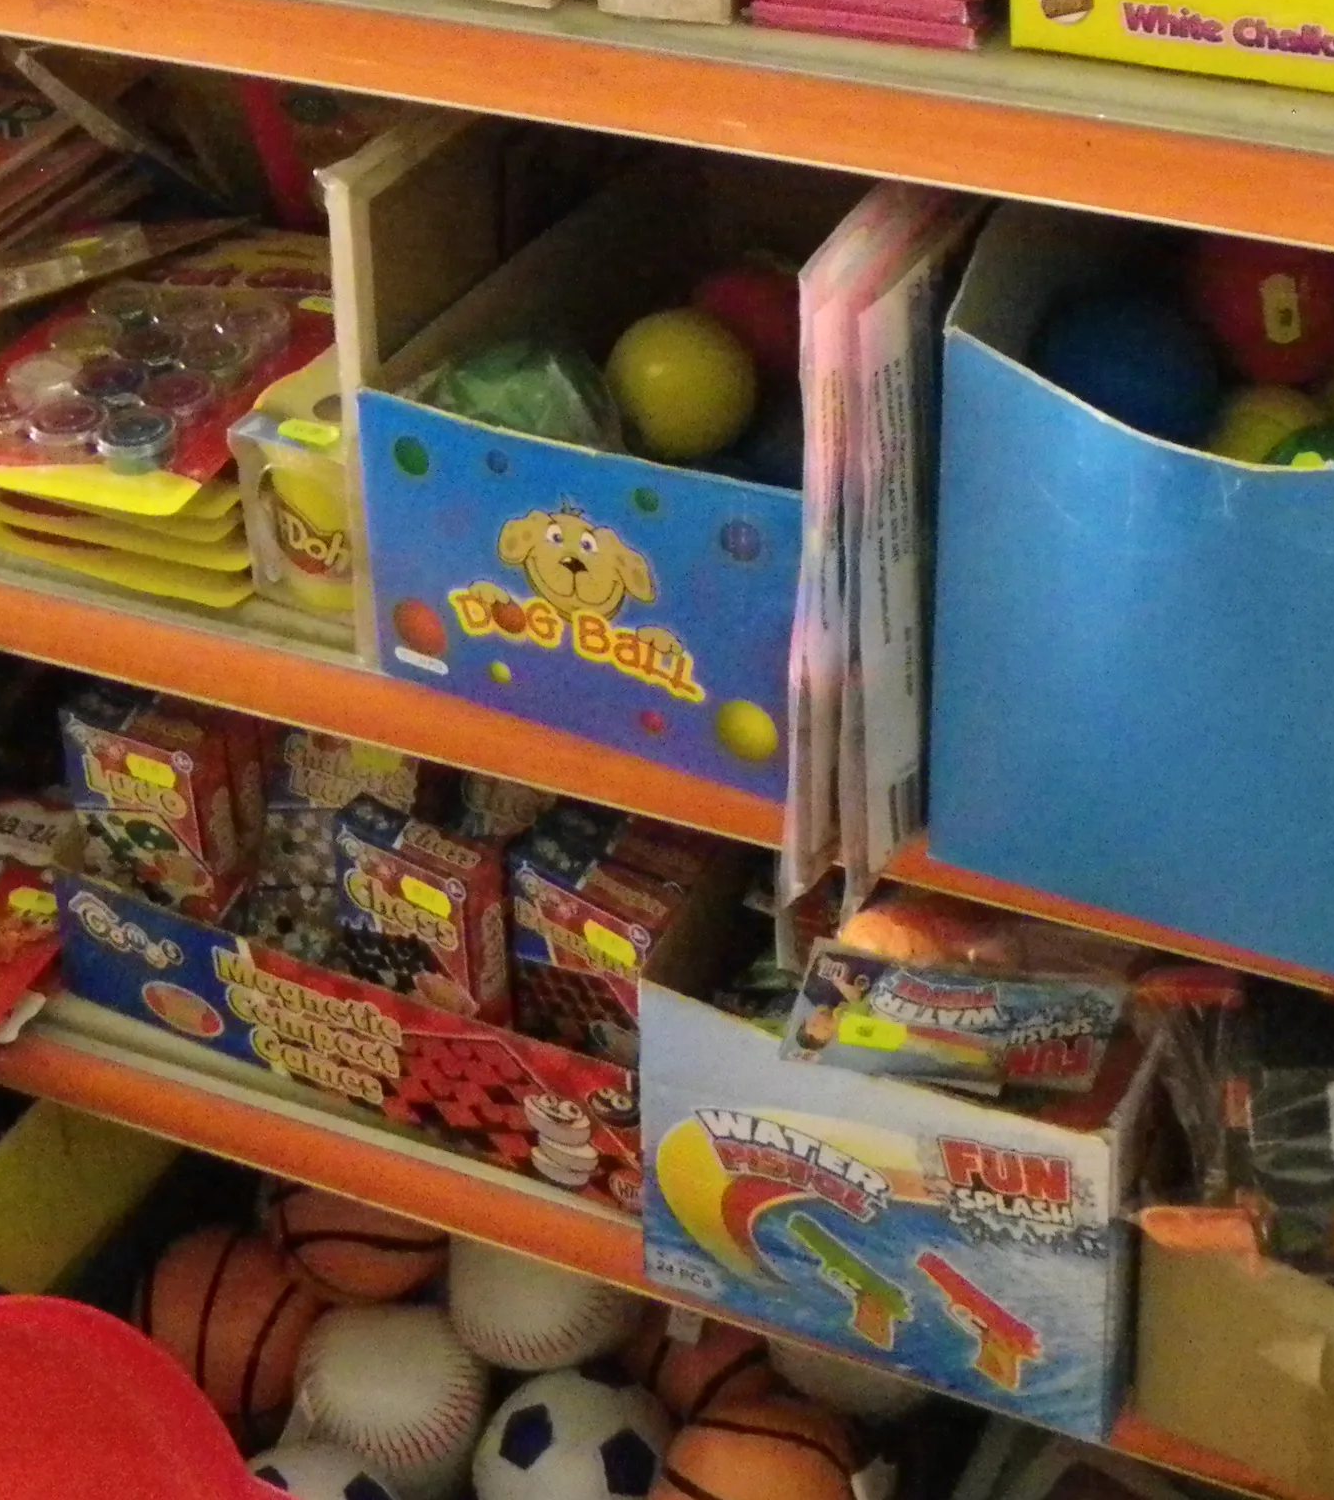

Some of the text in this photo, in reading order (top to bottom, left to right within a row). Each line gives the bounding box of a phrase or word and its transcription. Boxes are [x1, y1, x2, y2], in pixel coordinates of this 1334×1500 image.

[1122, 0, 1225, 45] White
[345, 870, 457, 950] Chess
[215, 949, 402, 1045] Magnetic
[230, 987, 400, 1077] Compact
[252, 1030, 383, 1103] Games
[697, 1108, 890, 1197] WATER
[941, 1136, 1071, 1202] FUN
[957, 1189, 1072, 1227] SPLASH
